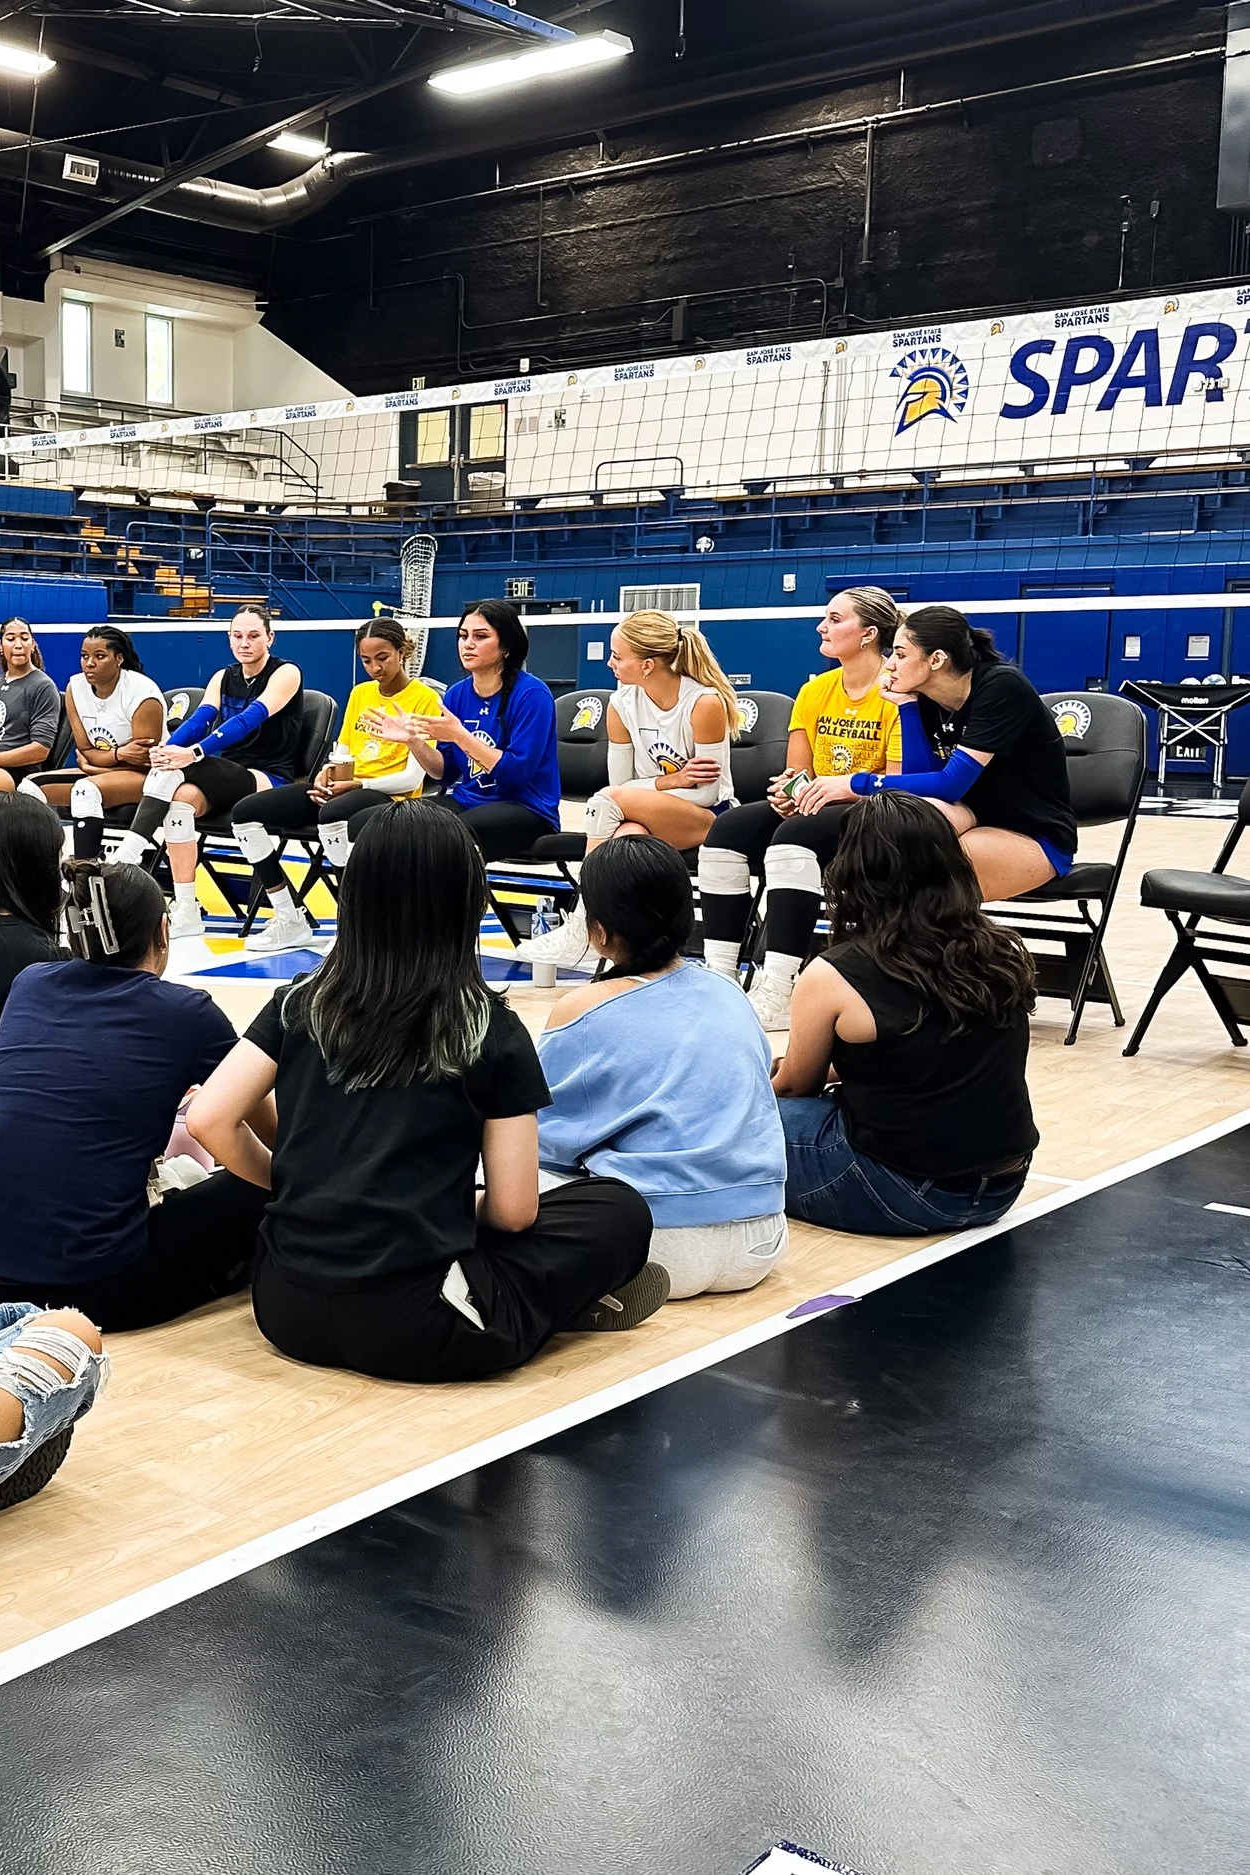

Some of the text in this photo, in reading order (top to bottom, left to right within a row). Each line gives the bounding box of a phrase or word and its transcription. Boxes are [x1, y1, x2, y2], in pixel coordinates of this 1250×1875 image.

[1089, 306, 1110, 315] STATE
[1054, 313, 1110, 328] SPARTANS
[924, 327, 942, 335] STATE
[892, 334, 942, 348] SPARTANS
[746, 352, 791, 366] SPARTANS
[999, 317, 1250, 419] SPAR
[614, 369, 654, 382] SPARTANS
[494, 384, 531, 396] SPARTANS
[385, 397, 418, 408] SPARTANS
[512, 581, 530, 598] EXIT
[1181, 696, 1209, 705] molten
[856, 720, 882, 730] STATE
[818, 725, 882, 741] OLLEYBALL
